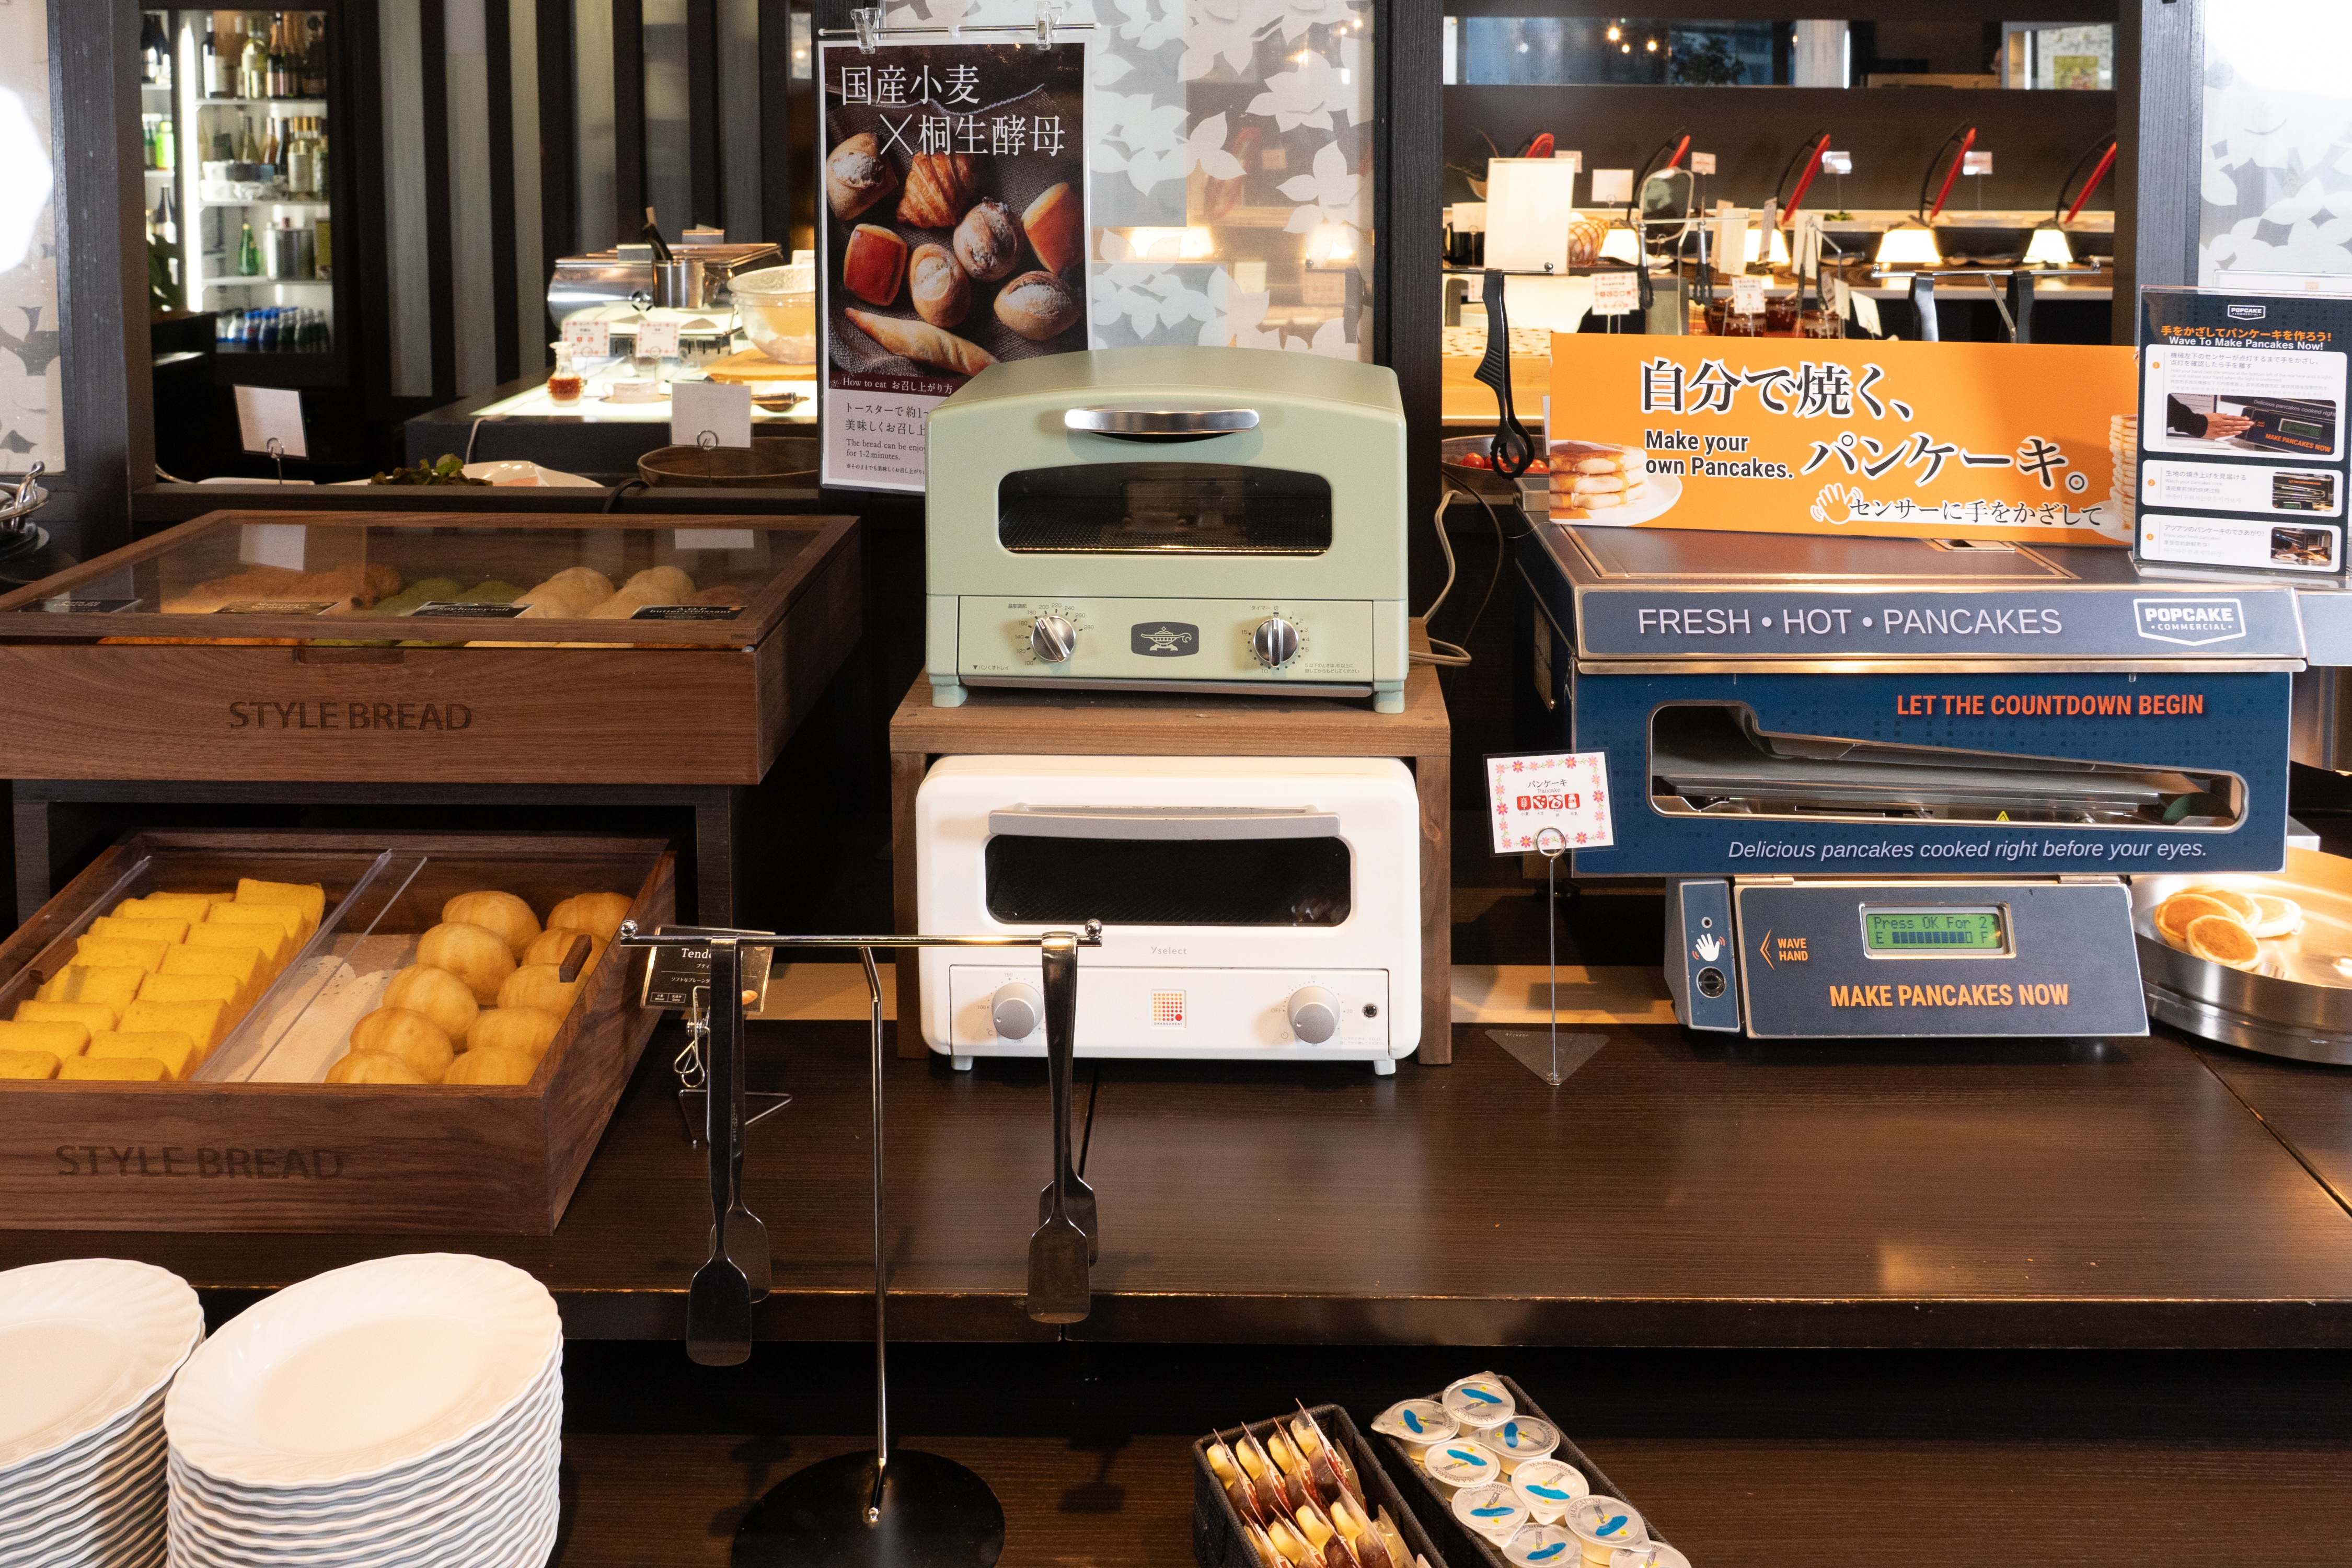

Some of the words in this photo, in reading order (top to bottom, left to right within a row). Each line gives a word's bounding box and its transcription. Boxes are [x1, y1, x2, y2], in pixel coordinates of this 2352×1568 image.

[841, 64, 981, 106] 国産小麦
[2169, 336, 2196, 345] Wave
[2199, 337, 2212, 346] To
[2215, 338, 2242, 347] Make
[2245, 339, 2294, 349] Pancakes
[2297, 341, 2324, 351] Now!
[843, 377, 862, 386] How
[892, 381, 953, 395] お召し上がり方
[1640, 359, 1913, 421] 自分で焼く、
[862, 440, 882, 448] bread
[1645, 430, 1699, 451] Make
[1705, 434, 1749, 455] your
[2265, 433, 2281, 442] MAKE
[2282, 436, 2314, 449] PANCAKES
[2314, 444, 2332, 453] NOW
[846, 448, 857, 457] for
[871, 452, 901, 460] minutes.
[1645, 457, 1685, 476] own
[1690, 454, 1794, 479] Pancakes.
[1801, 433, 2089, 493] パンケーキ。
[1850, 499, 2103, 527] センサーに手をかざして
[1638, 608, 1751, 635] FRESH
[1782, 608, 1853, 635] HOT
[1883, 607, 2062, 635] PANCAKES
[2145, 608, 2234, 621] POPCAKE
[1896, 695, 1936, 716] LET
[1941, 695, 1985, 716] THE
[1990, 694, 2133, 716] COUNTDOWN
[2138, 694, 2204, 716] BEGIN
[230, 700, 339, 730] STYLE
[348, 702, 471, 731] BREAD
[1527, 778, 1567, 788] パンケーキ
[1728, 840, 1817, 859] Delicious
[1821, 840, 1915, 862] pancakes
[1918, 839, 1989, 859] cooked
[1993, 839, 2038, 863] right
[2042, 839, 2104, 858] before
[2107, 843, 2152, 863] your
[2155, 843, 2207, 863] eyes.
[1874, 916, 1915, 929] Press
[1922, 916, 1940, 929] OK
[1946, 916, 1971, 929] For
[1777, 937, 1807, 949] WAVE
[1875, 931, 1885, 944] E
[1980, 930, 1989, 943] F
[1778, 950, 1809, 961] HAND
[1829, 985, 1894, 1007] MAKE
[1898, 984, 2014, 1006] PANCAKES
[2019, 984, 2069, 1006] NOW
[55, 1145, 188, 1178] STYLE
[200, 1147, 344, 1180] BREAD
[1451, 1406, 1496, 1423] MARGARINE
[1431, 1465, 1475, 1483] MARGARINE
[1529, 1461, 1577, 1477] MARGARINE
